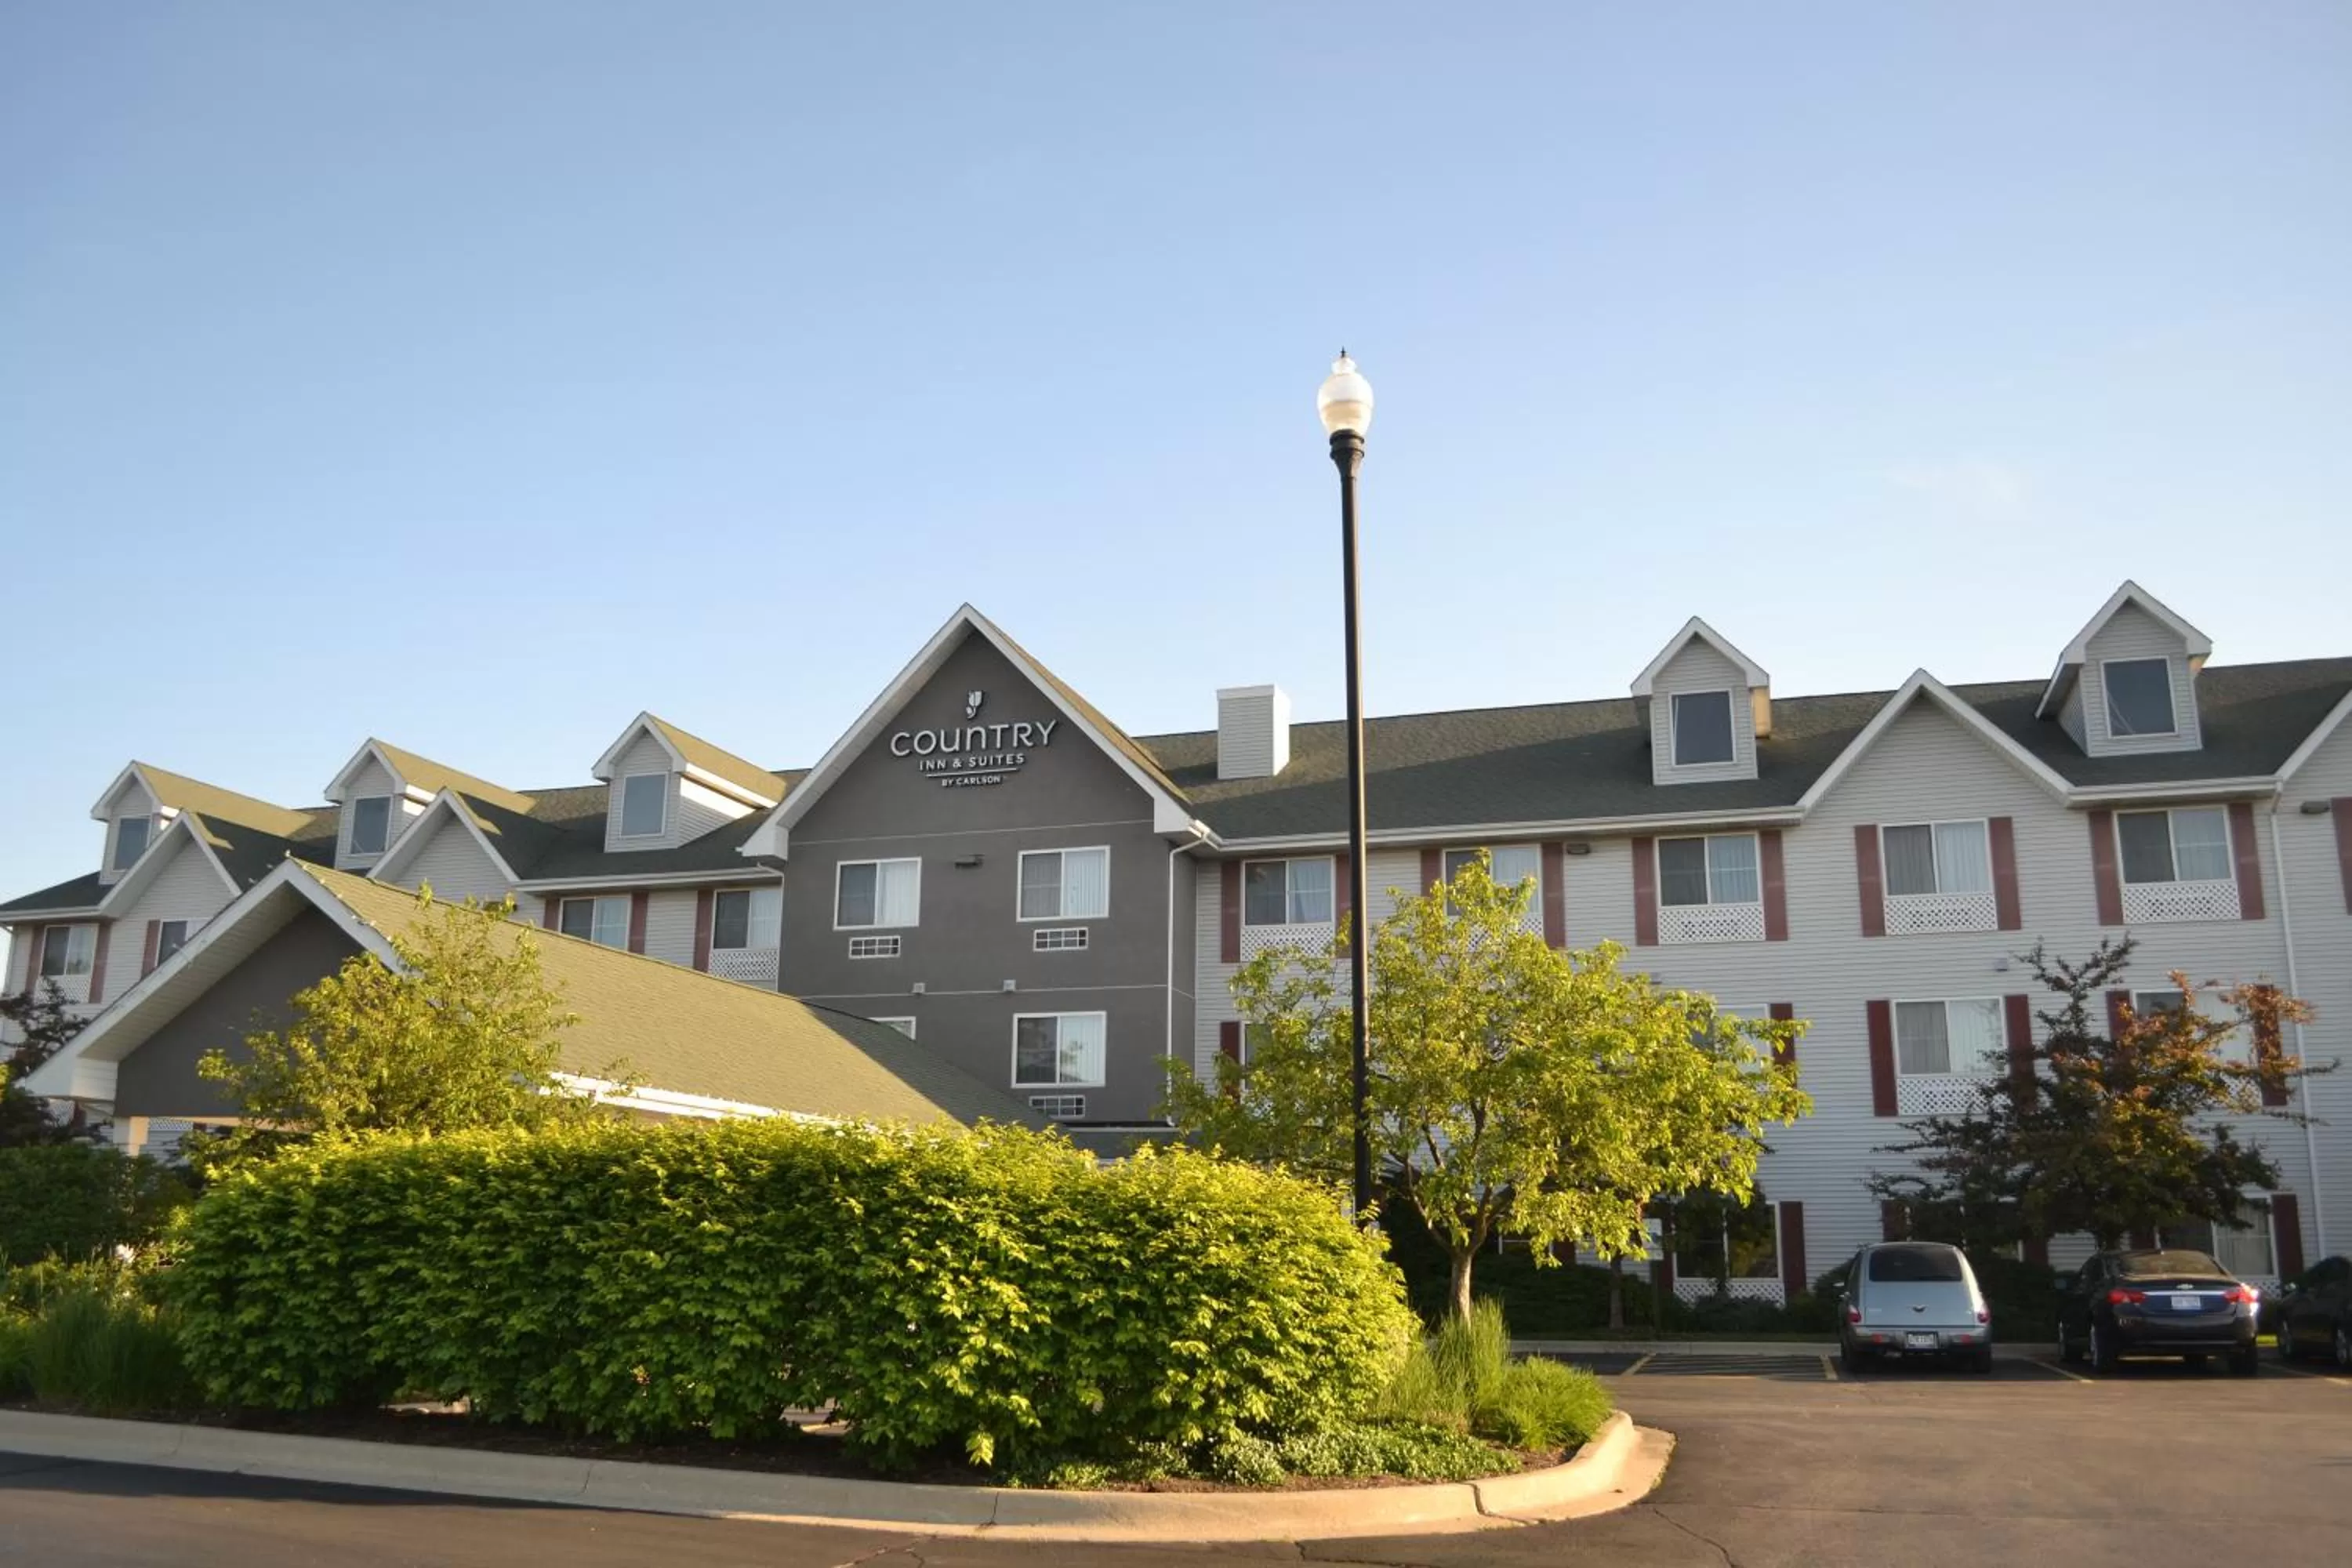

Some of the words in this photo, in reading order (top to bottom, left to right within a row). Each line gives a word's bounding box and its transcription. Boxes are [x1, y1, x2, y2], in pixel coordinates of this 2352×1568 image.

[891, 720, 1057, 756] COUNTRY
[919, 759, 947, 771] INN
[953, 757, 962, 768] &
[968, 753, 1025, 768] SUITES
[942, 778, 954, 786] BY
[956, 775, 1001, 785] CARLSON
